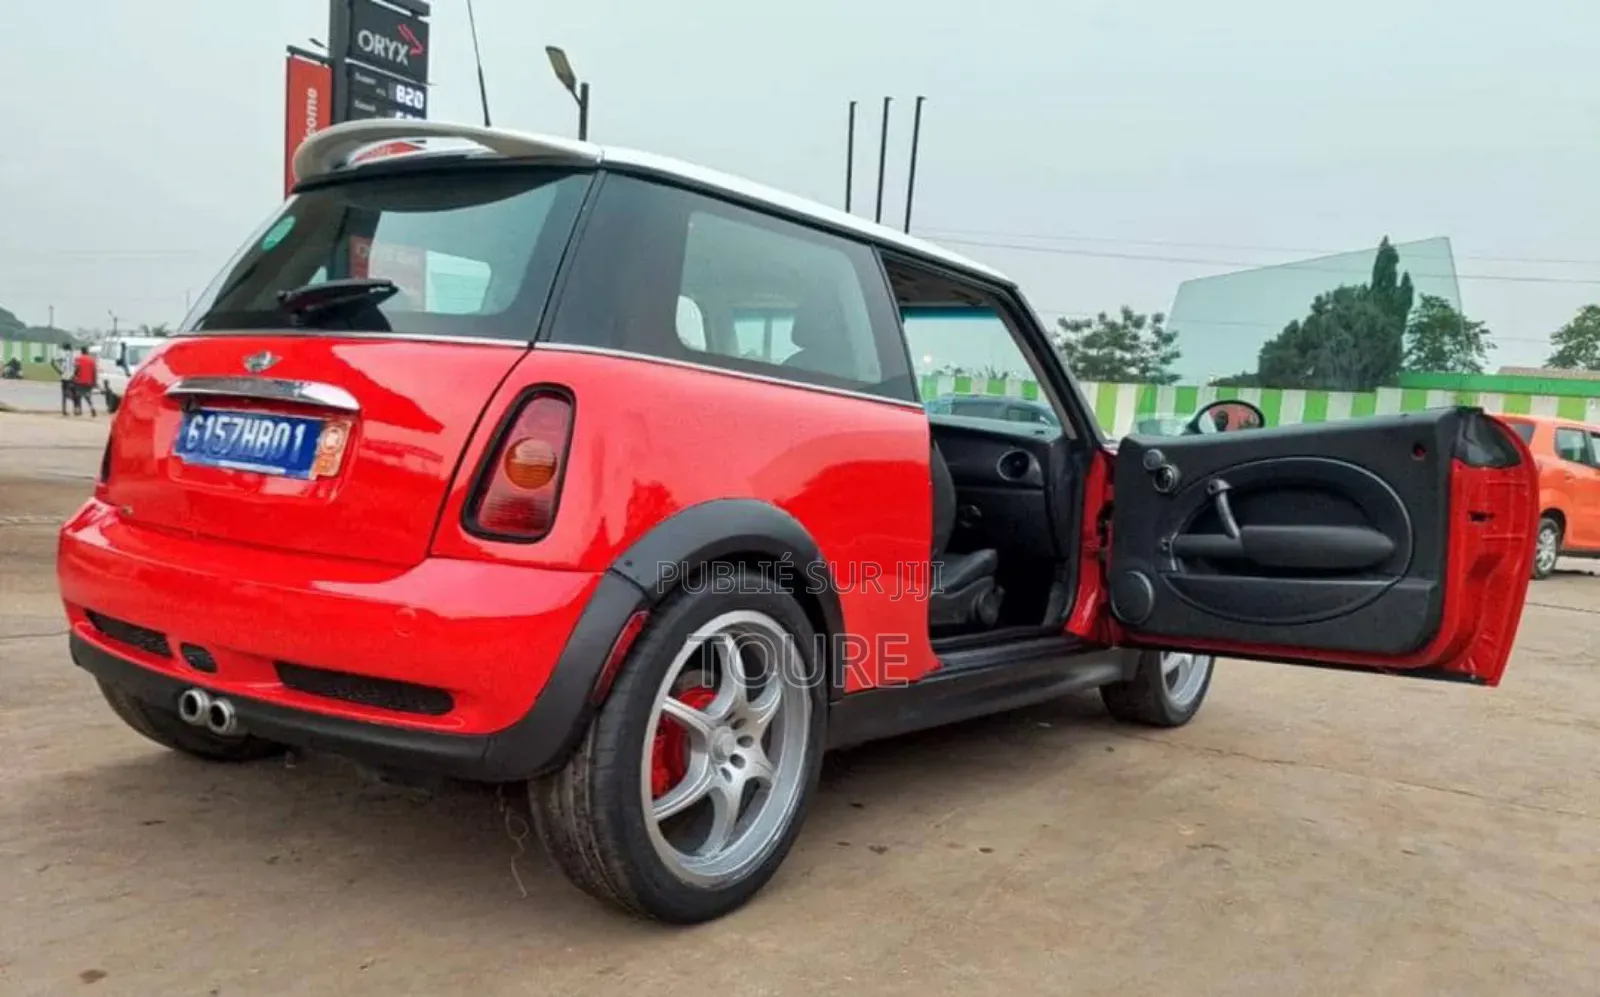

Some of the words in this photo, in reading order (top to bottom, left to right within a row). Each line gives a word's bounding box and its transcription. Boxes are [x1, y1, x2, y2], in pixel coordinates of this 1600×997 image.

[357, 29, 410, 66] ORYX
[304, 88, 318, 141] come
[185, 414, 307, 463] 6157HB01
